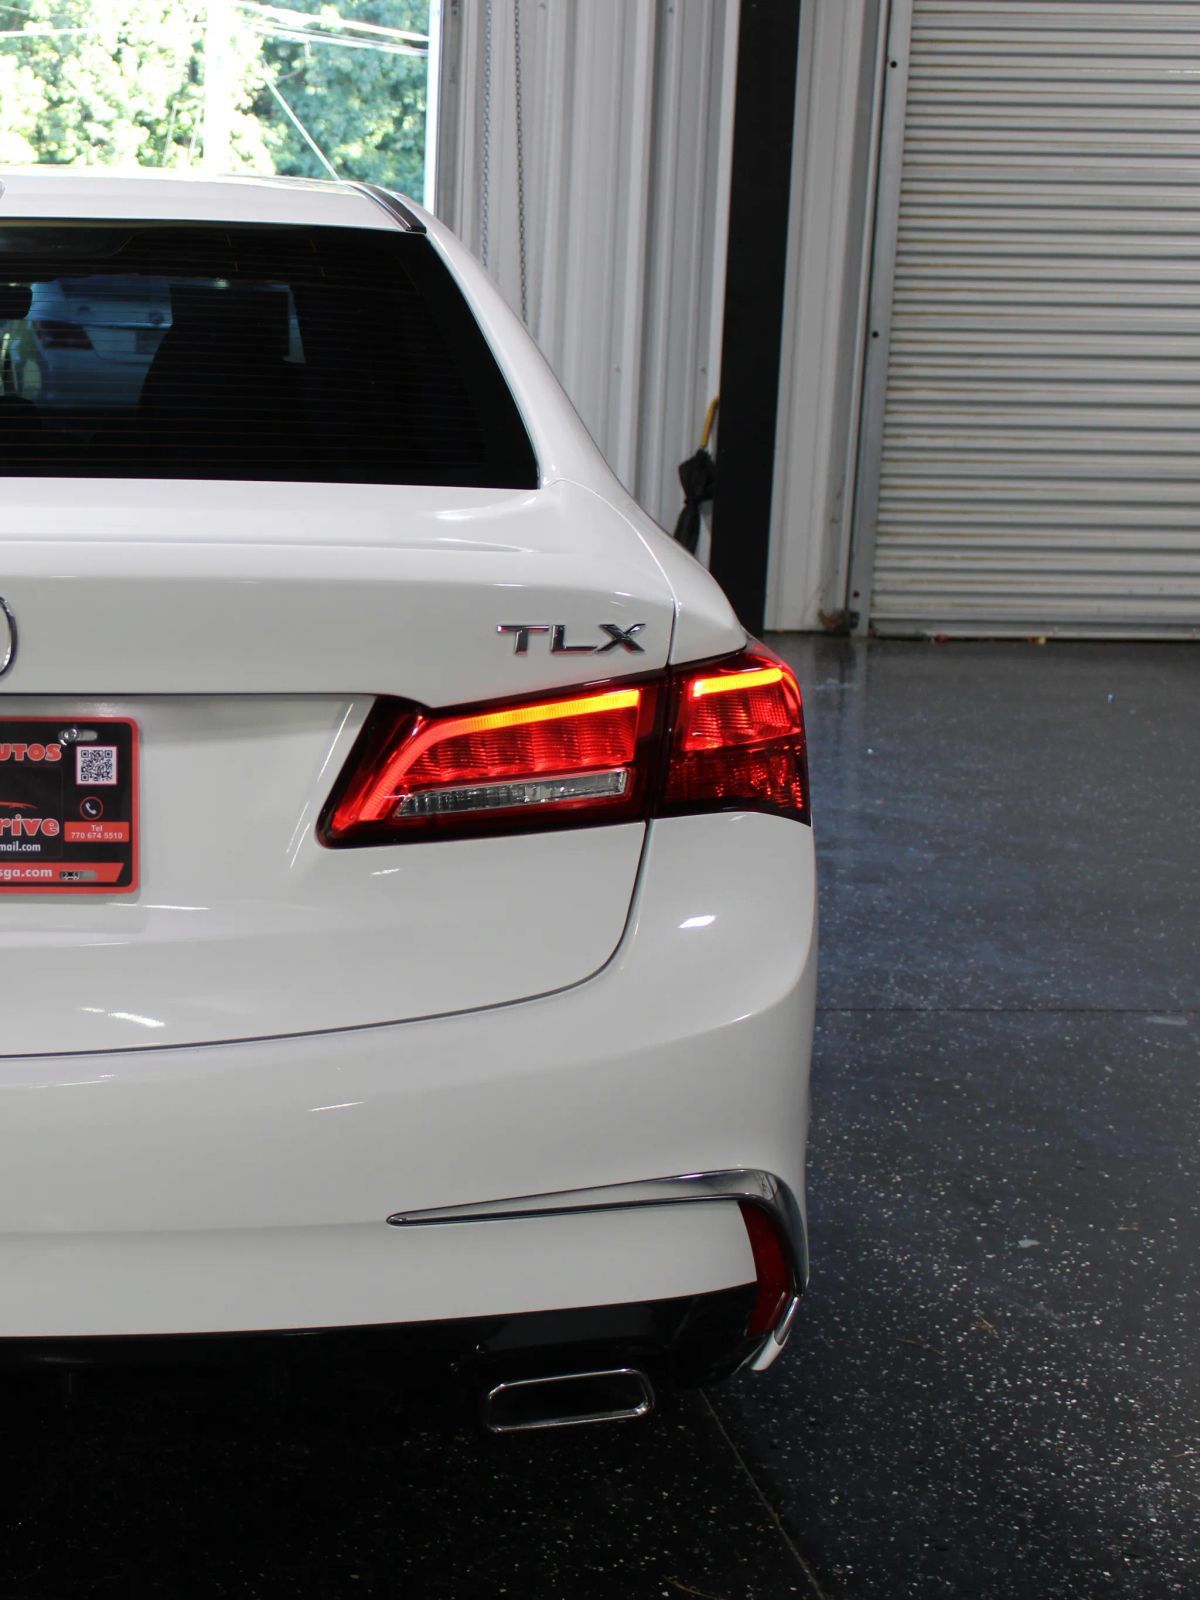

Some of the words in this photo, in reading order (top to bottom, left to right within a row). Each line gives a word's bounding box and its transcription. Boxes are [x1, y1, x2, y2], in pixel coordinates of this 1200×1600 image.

[496, 623, 646, 655] TLX
[91, 824, 104, 832] Tel
[71, 831, 86, 839] 770
[87, 831, 102, 839] 674
[103, 831, 123, 839] 5510
